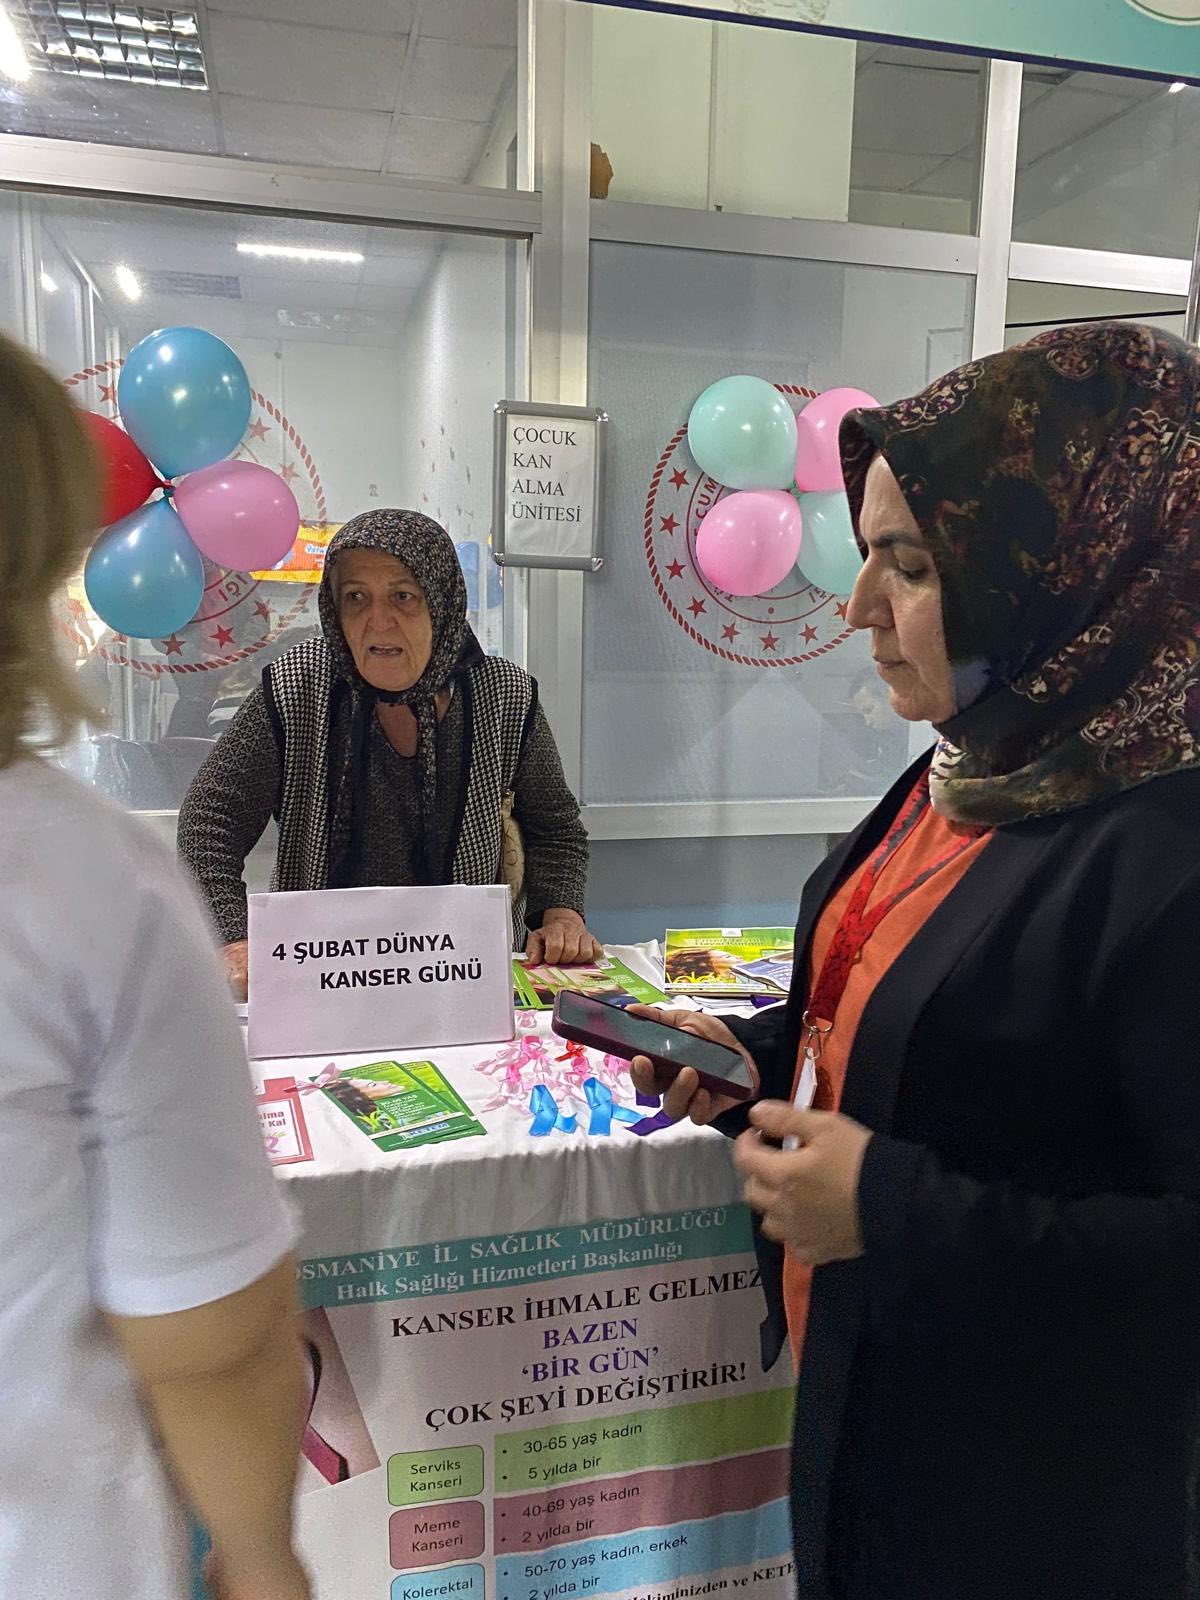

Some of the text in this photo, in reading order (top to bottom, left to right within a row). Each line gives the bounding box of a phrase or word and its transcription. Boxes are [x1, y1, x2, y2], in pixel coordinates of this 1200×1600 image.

[513, 427, 577, 446] ÇOCUK
[512, 453, 552, 469] KAN
[512, 479, 565, 496] ALMA
[512, 501, 583, 523] ÜNİTESİ
[272, 932, 455, 964] 4 ŞUBAT DÜNYA
[320, 958, 482, 989] KANSER GÜNÜ
[434, 1244, 458, 1264] İL
[471, 1232, 561, 1259] SAĞLIK
[580, 1207, 727, 1244] MÜDÜRLÜĞÜ
[336, 1242, 683, 1301] Halk Sağlığı Hizmetleri Başkanlığı
[391, 1307, 516, 1338] KANSER
[524, 1286, 641, 1321] İHMALE
[543, 1318, 638, 1350] BAZEN
[426, 1362, 746, 1431] ÇOK ŞEYİ DEĞİŞTİRİR!
[523, 1423, 642, 1454] 30-65 yaş kadın
[410, 1460, 461, 1474] Serviks
[528, 1456, 602, 1481] 5 yılda bir
[409, 1476, 462, 1492] Kanseri
[522, 1485, 640, 1518] 40-69 yaş kadın
[414, 1519, 461, 1534] Meme
[522, 1517, 595, 1544] 2 yılda bir
[412, 1536, 464, 1553] Kanseri
[525, 1558, 567, 1577] 50-70
[570, 1553, 596, 1569] yaş
[649, 1535, 688, 1552] erkek
[403, 1578, 473, 1600] Kolerektal
[528, 1575, 601, 1600] 2 yılda bir
[732, 1578, 749, 1589] ve
